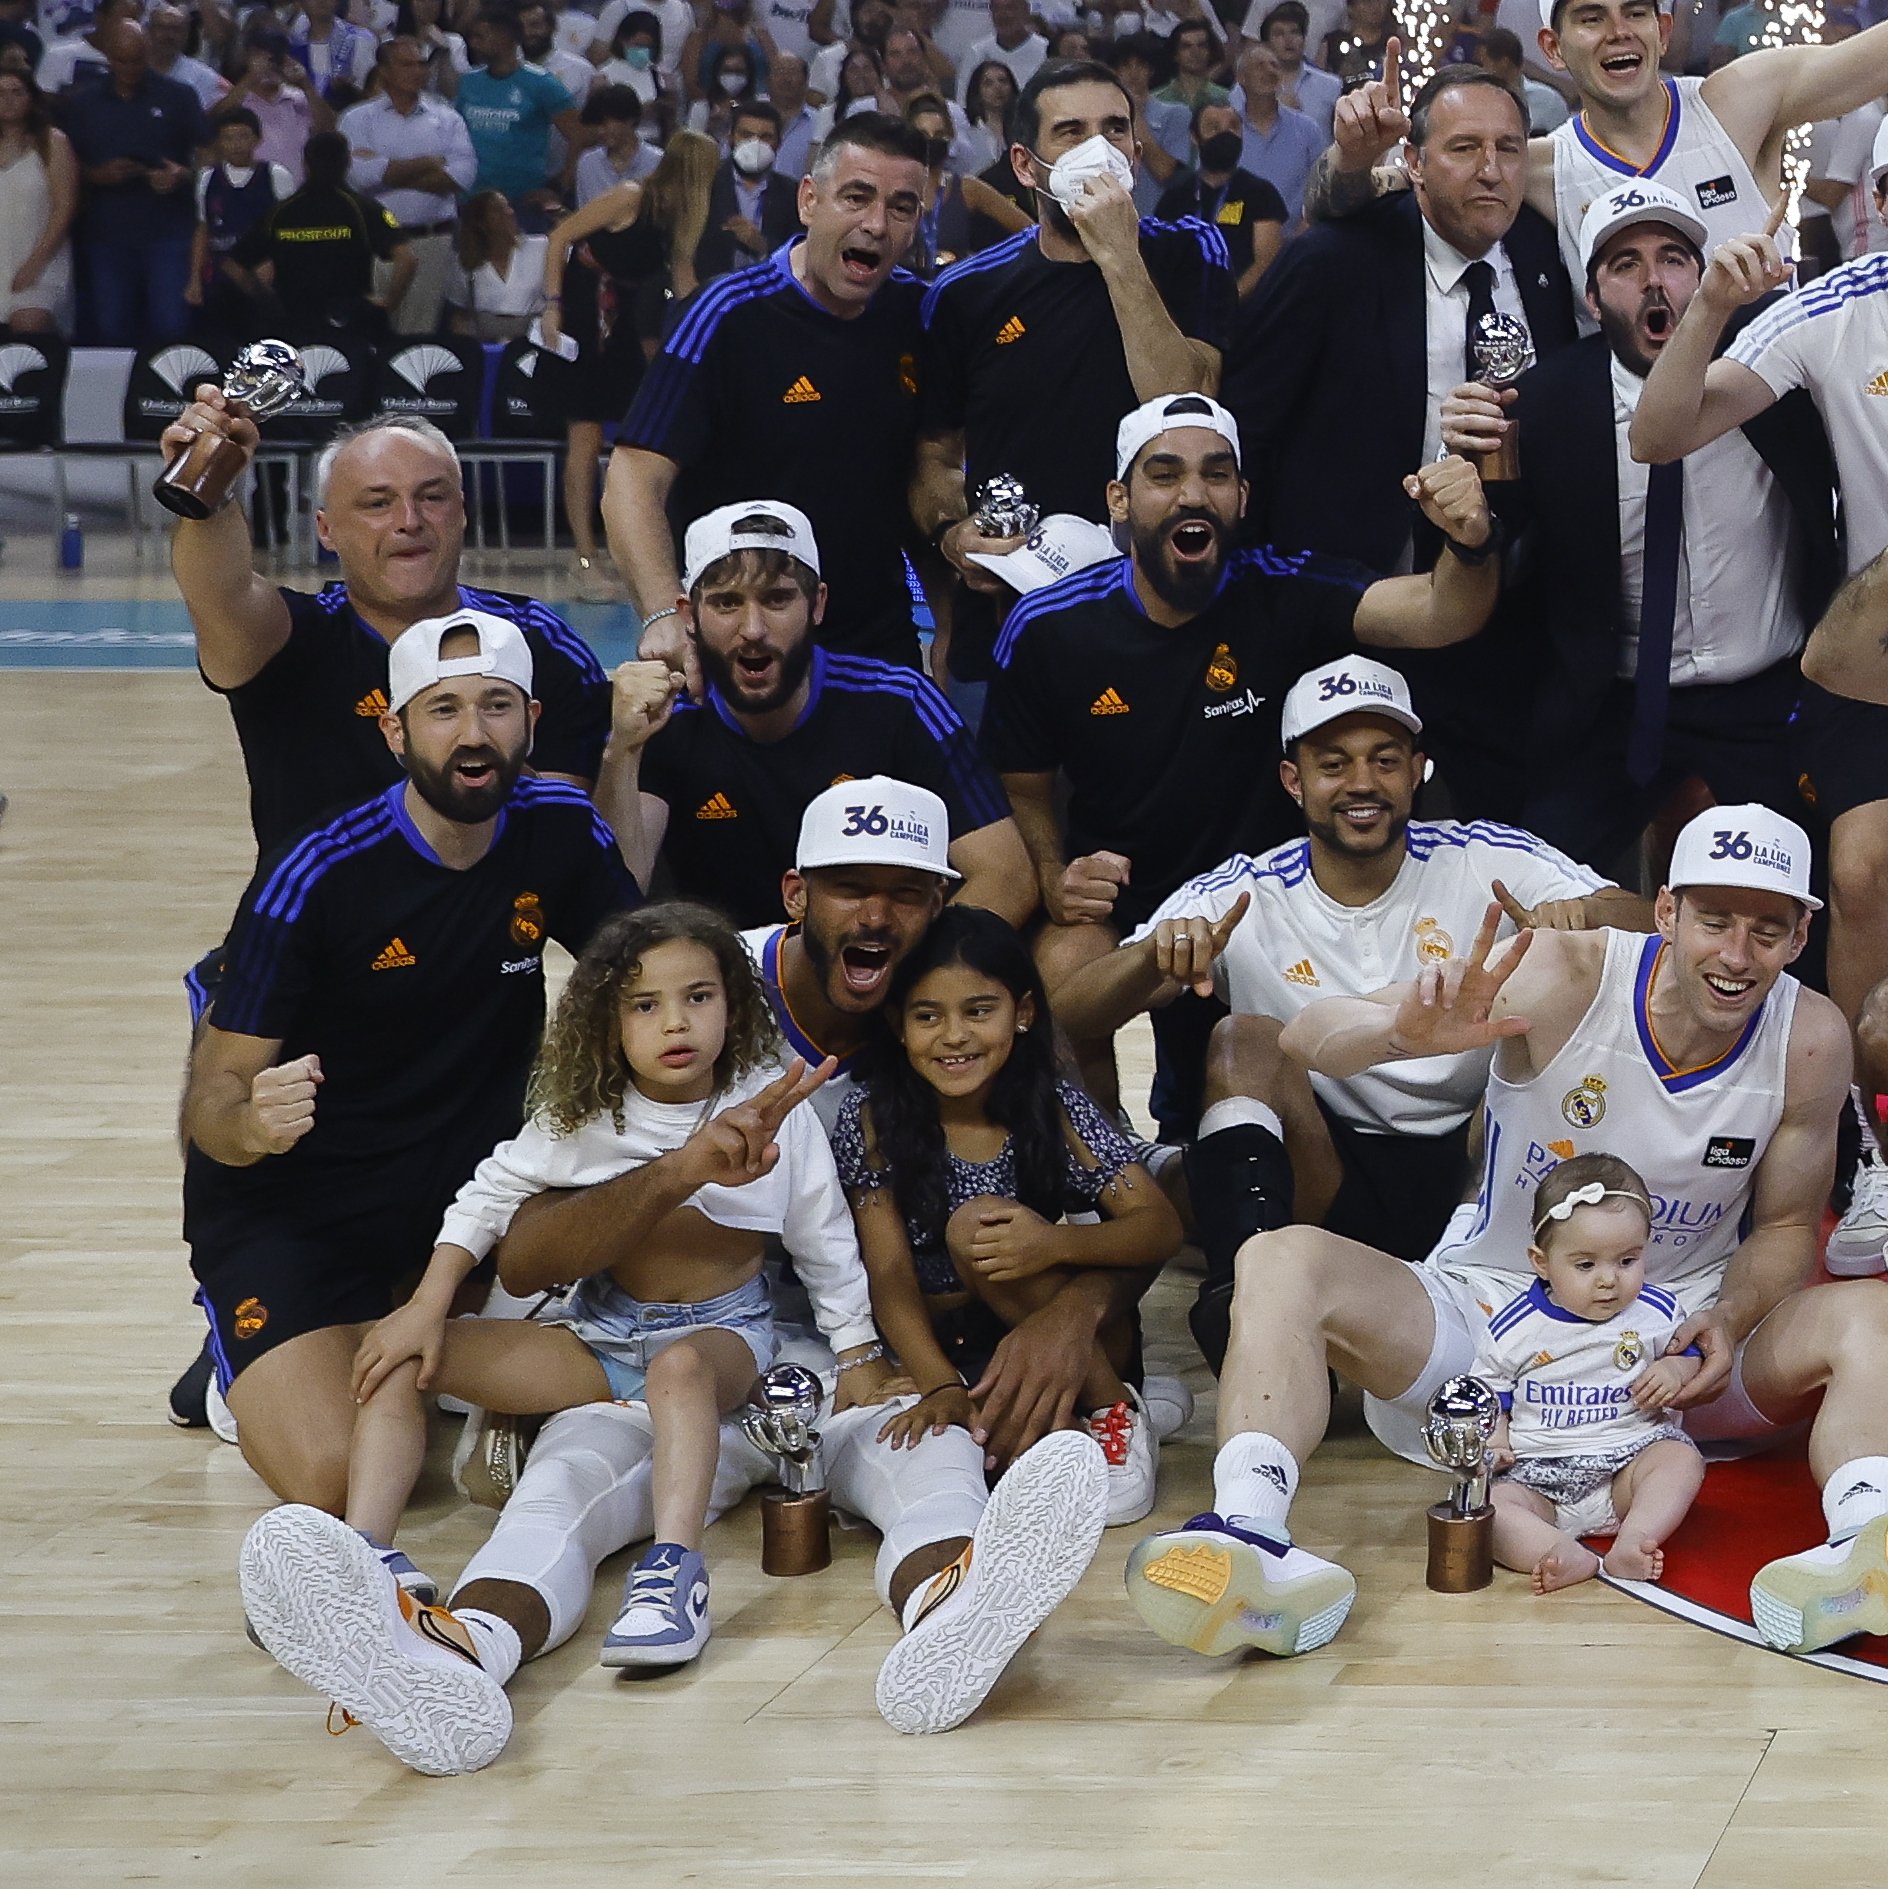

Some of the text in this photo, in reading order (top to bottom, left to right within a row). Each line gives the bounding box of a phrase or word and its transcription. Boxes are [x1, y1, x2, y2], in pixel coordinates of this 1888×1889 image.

[1609, 189, 1647, 215] 36
[784, 392, 821, 403] adidas
[1050, 549, 1070, 571] LIGA
[1318, 672, 1393, 702] 36 LA LIGA
[1090, 704, 1129, 715] adidas
[1204, 696, 1246, 719] Sanitas
[841, 805, 930, 839] 36 LA LIGA
[890, 830, 930, 845] CAMPEONES
[1708, 830, 1792, 868] 36 LA LIGA
[1753, 856, 1792, 876] CAMPEONES
[1706, 1155, 1748, 1166] endesa
[1710, 1146, 1730, 1160] liga
[1526, 1379, 1632, 1407] Emirates
[1541, 1405, 1619, 1428] FLY BETTER
